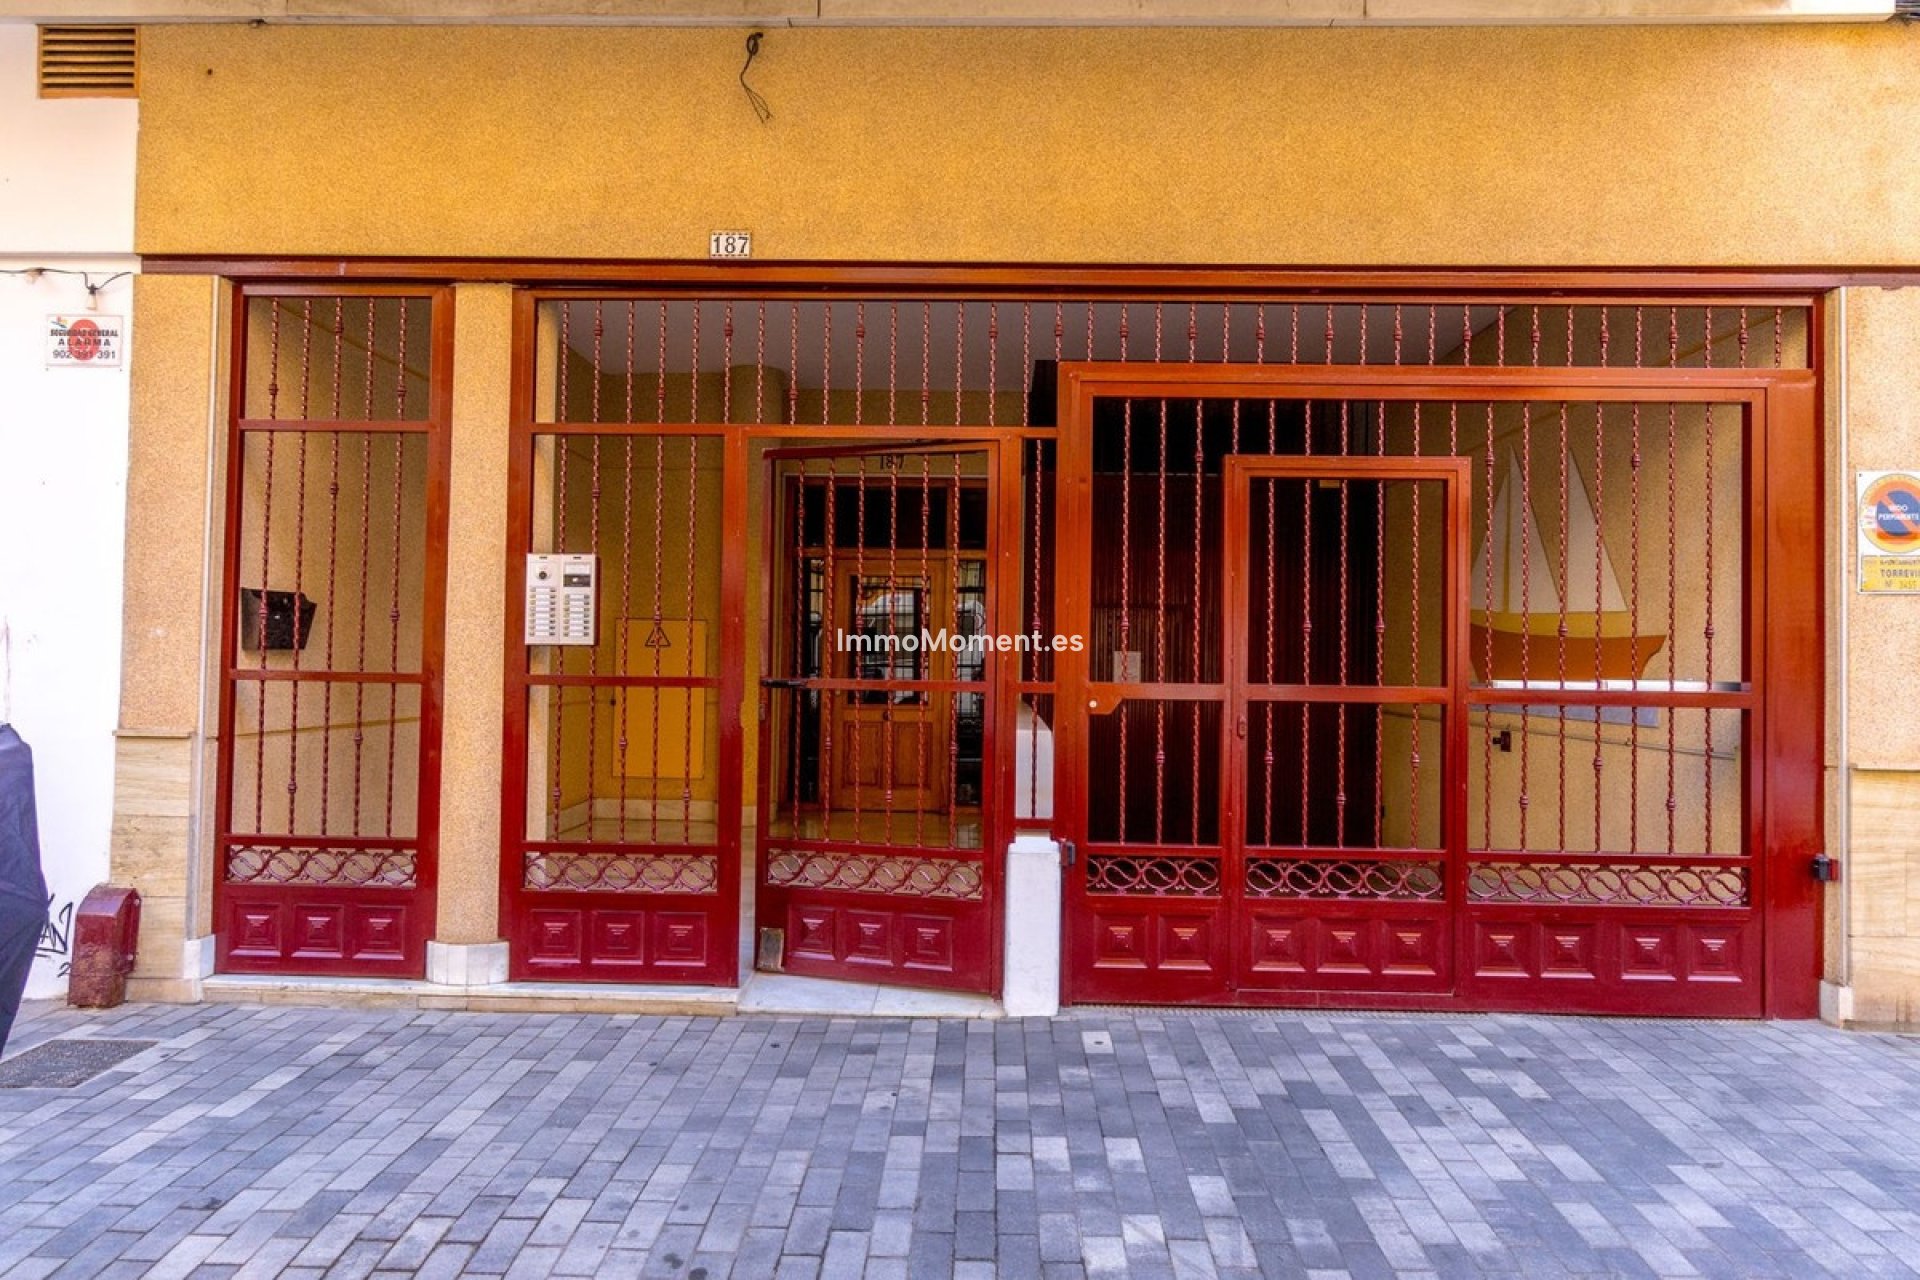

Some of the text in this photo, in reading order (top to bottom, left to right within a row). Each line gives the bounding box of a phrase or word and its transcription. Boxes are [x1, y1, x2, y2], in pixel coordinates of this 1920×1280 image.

[713, 236, 749, 254] 187
[88, 329, 118, 337] GENERAL
[53, 349, 72, 359] 902
[97, 349, 116, 359] 391
